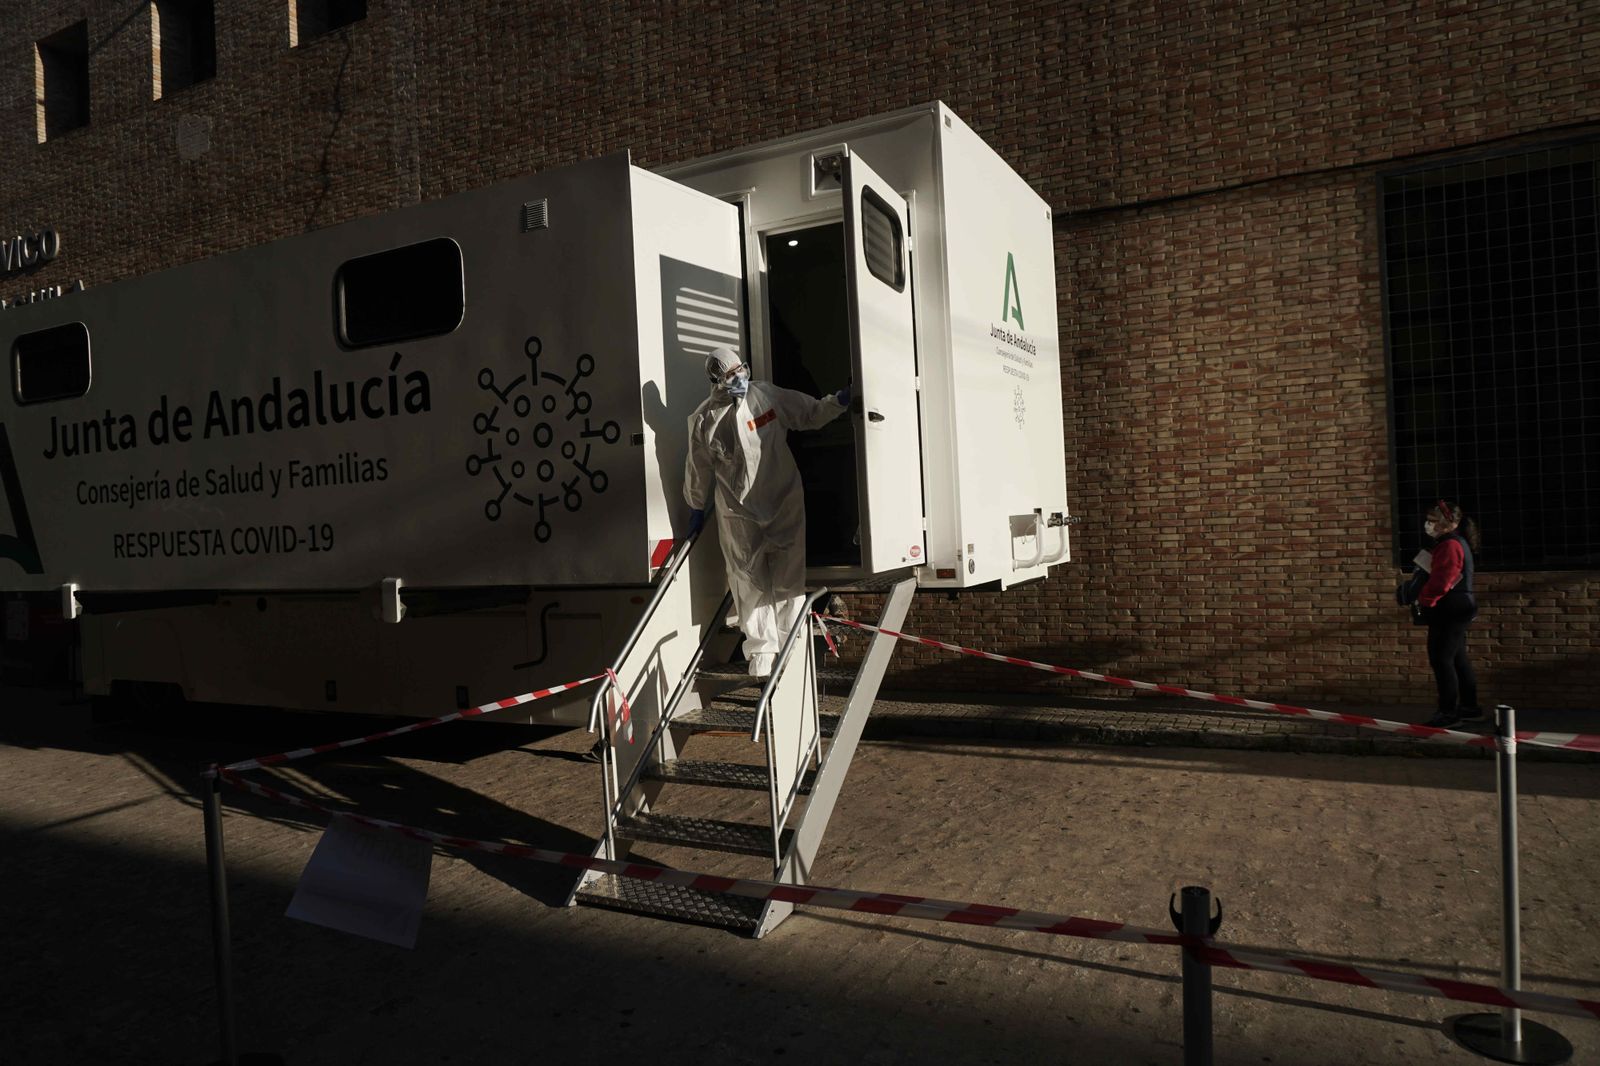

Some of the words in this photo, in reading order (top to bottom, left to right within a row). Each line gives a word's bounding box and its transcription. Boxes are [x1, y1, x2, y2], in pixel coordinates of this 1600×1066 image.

[990, 322, 1006, 342] Junta
[1007, 329, 1013, 345] de
[42, 408, 138, 460] Junta
[147, 394, 194, 447] de
[202, 352, 432, 440] Andalucía
[76, 469, 171, 510] Consejería
[175, 469, 201, 499] de
[204, 461, 264, 497] Salud
[268, 468, 284, 499] y
[288, 451, 389, 490] Familias
[113, 528, 227, 560] RESPUESTA
[230, 522, 335, 557] COVID-19
